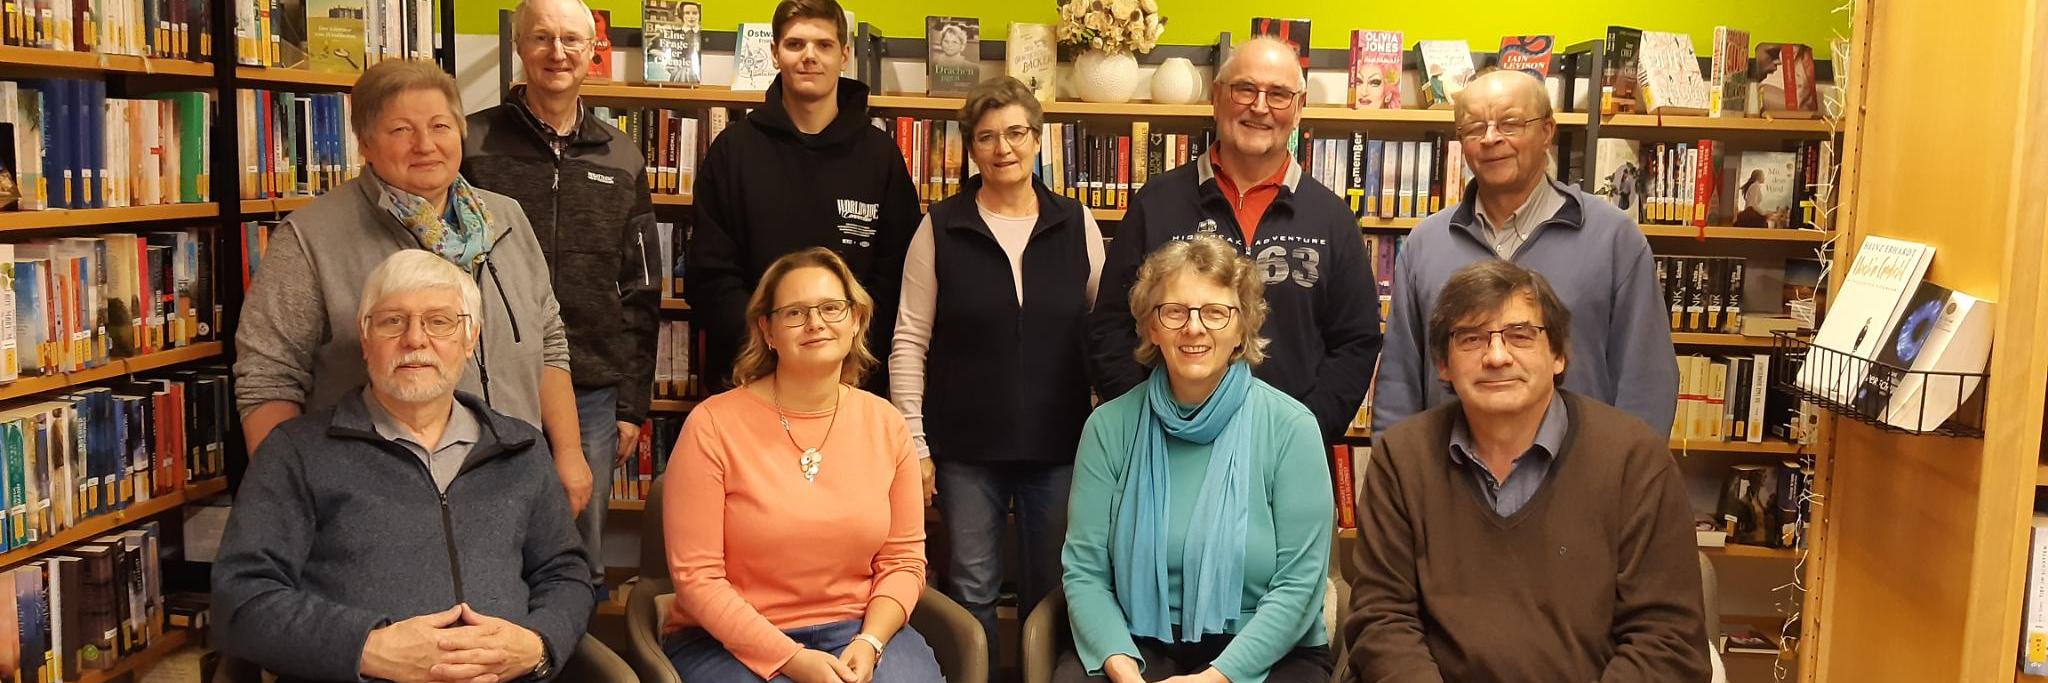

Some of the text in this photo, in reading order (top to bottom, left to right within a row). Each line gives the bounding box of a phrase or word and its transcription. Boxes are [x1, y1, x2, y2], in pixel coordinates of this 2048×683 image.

[663, 30, 685, 40] Eine
[1366, 31, 1398, 43] OLIVIA
[659, 39, 689, 50] Frage
[1366, 41, 1399, 53] JONES
[1503, 62, 1545, 70] LEVISON
[1766, 184, 1784, 193] Wind
[837, 199, 880, 220] WORLDWIDE
[1255, 235, 1327, 246] ADVENTURE
[1256, 245, 1320, 289] 63
[1672, 291, 1682, 306] NK
[1692, 293, 1702, 307] NK
[1712, 294, 1721, 307] NK
[1729, 294, 1739, 307] NK
